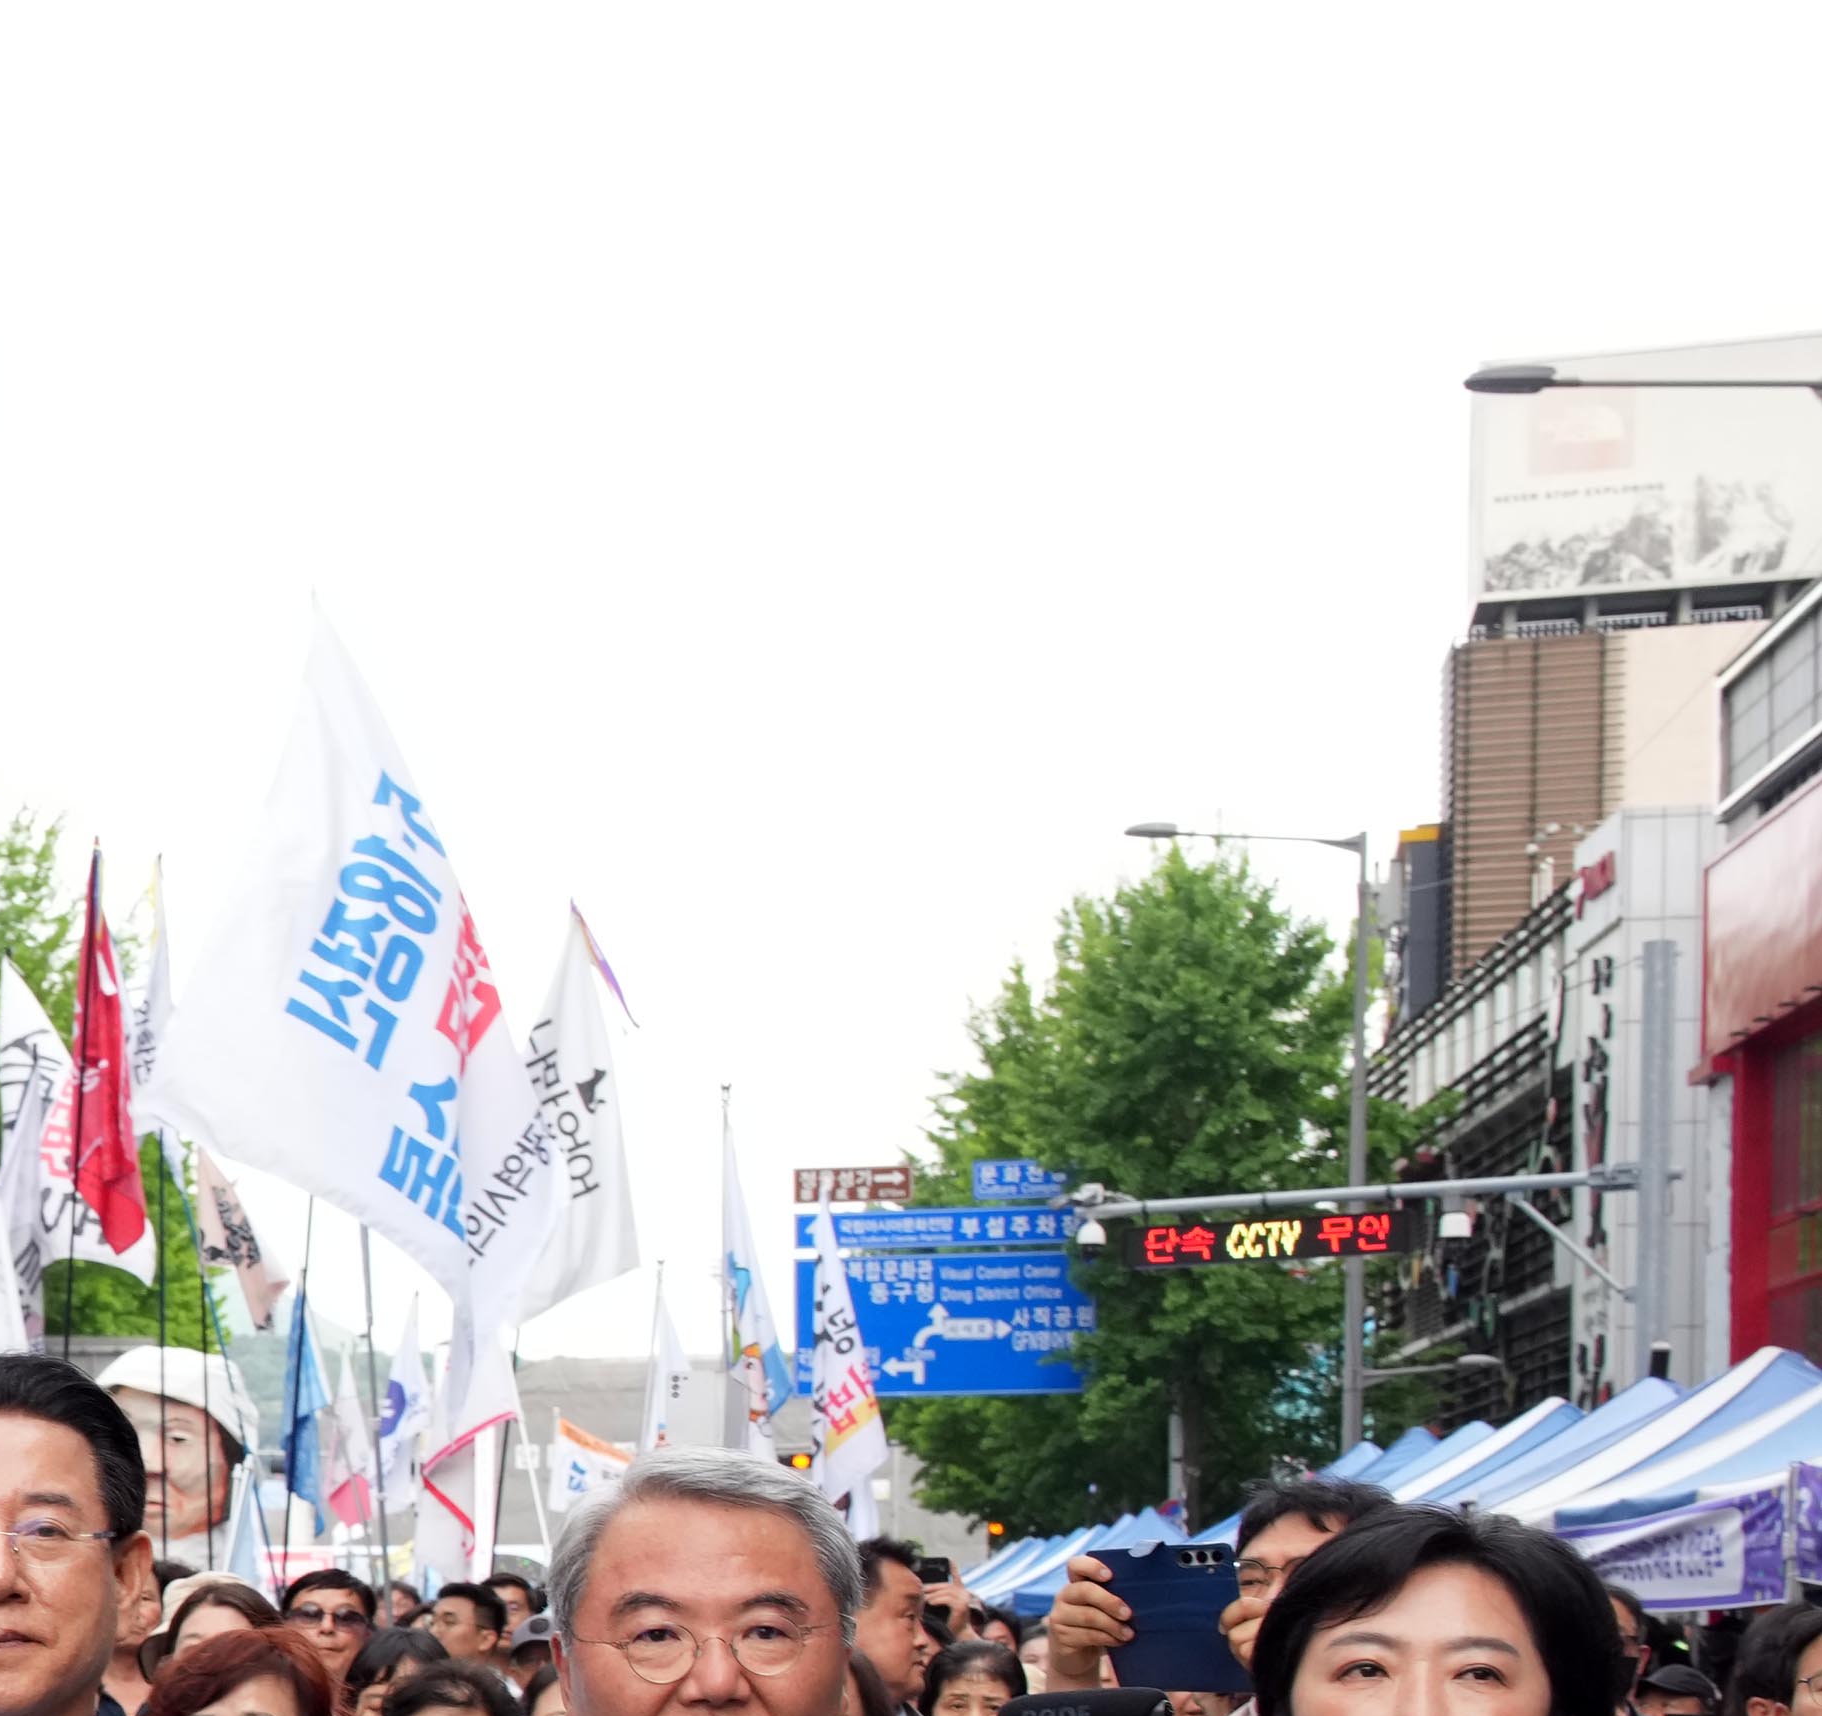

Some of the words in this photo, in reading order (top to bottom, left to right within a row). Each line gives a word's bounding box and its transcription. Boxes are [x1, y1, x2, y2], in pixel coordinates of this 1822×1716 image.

[1144, 1226, 1215, 1263] 단속
[1225, 1219, 1303, 1259] CCTV
[1317, 1214, 1390, 1252] 무인
